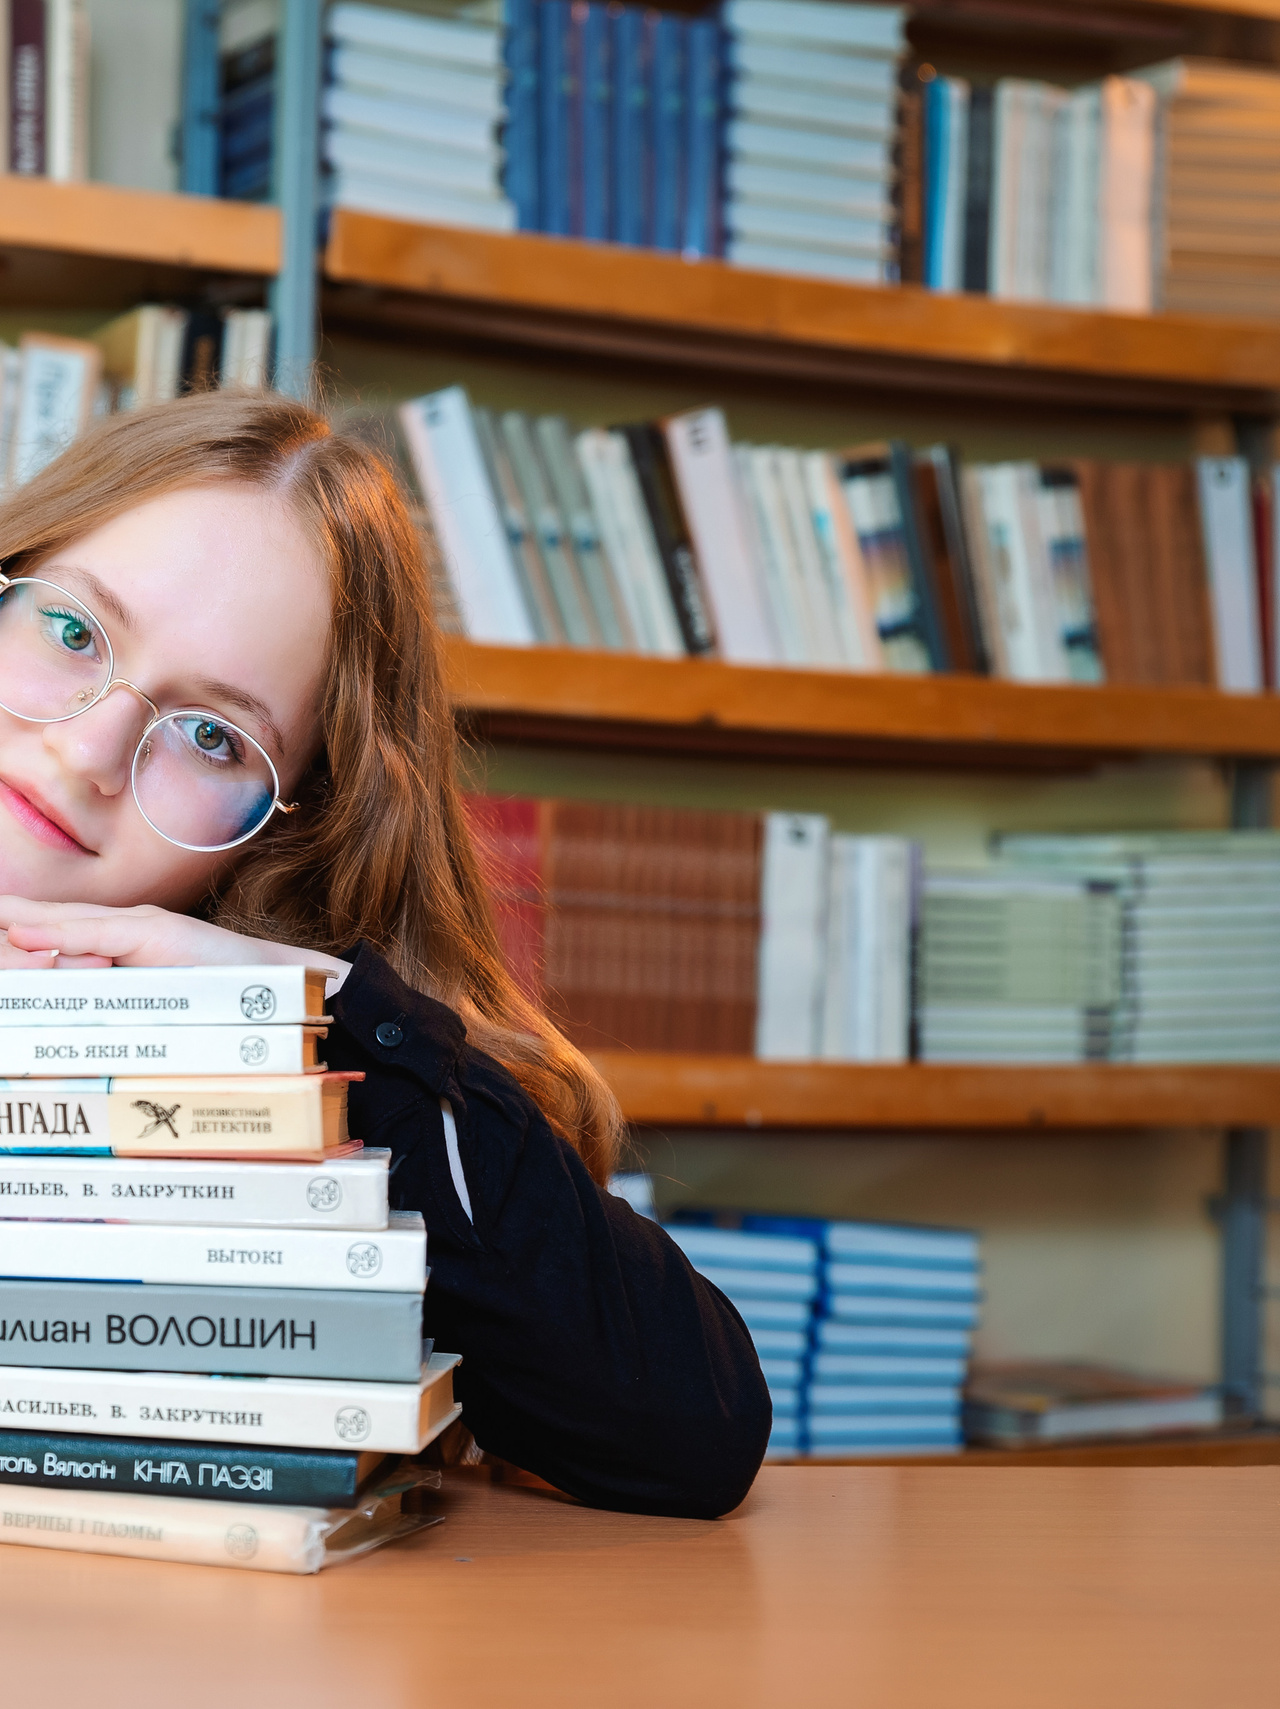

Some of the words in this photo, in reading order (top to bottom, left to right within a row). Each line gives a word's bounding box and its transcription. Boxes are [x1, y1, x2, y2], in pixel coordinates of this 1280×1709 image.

[94, 997, 190, 1011] ВАМПИЛОВ
[34, 1045, 80, 1059] ВОСЬ
[85, 1044, 129, 1059] ЯКІЯ
[135, 1044, 167, 1059] МЫ
[190, 1120, 273, 1134] ДЕТЕКТИВ
[82, 1183, 98, 1197] В.
[111, 1183, 235, 1200] ЗАКРУТКИН
[207, 1248, 283, 1265] ВЫТОКІ
[105, 1313, 317, 1351] ВОЛОШИН
[110, 1404, 127, 1419] В.
[139, 1406, 263, 1427] ЗАКРУТКИН
[42, 1452, 117, 1480] Вялюгін
[2, 1511, 73, 1534] ВЕРШЫ
[91, 1520, 164, 1542] ПАЭМЫ
